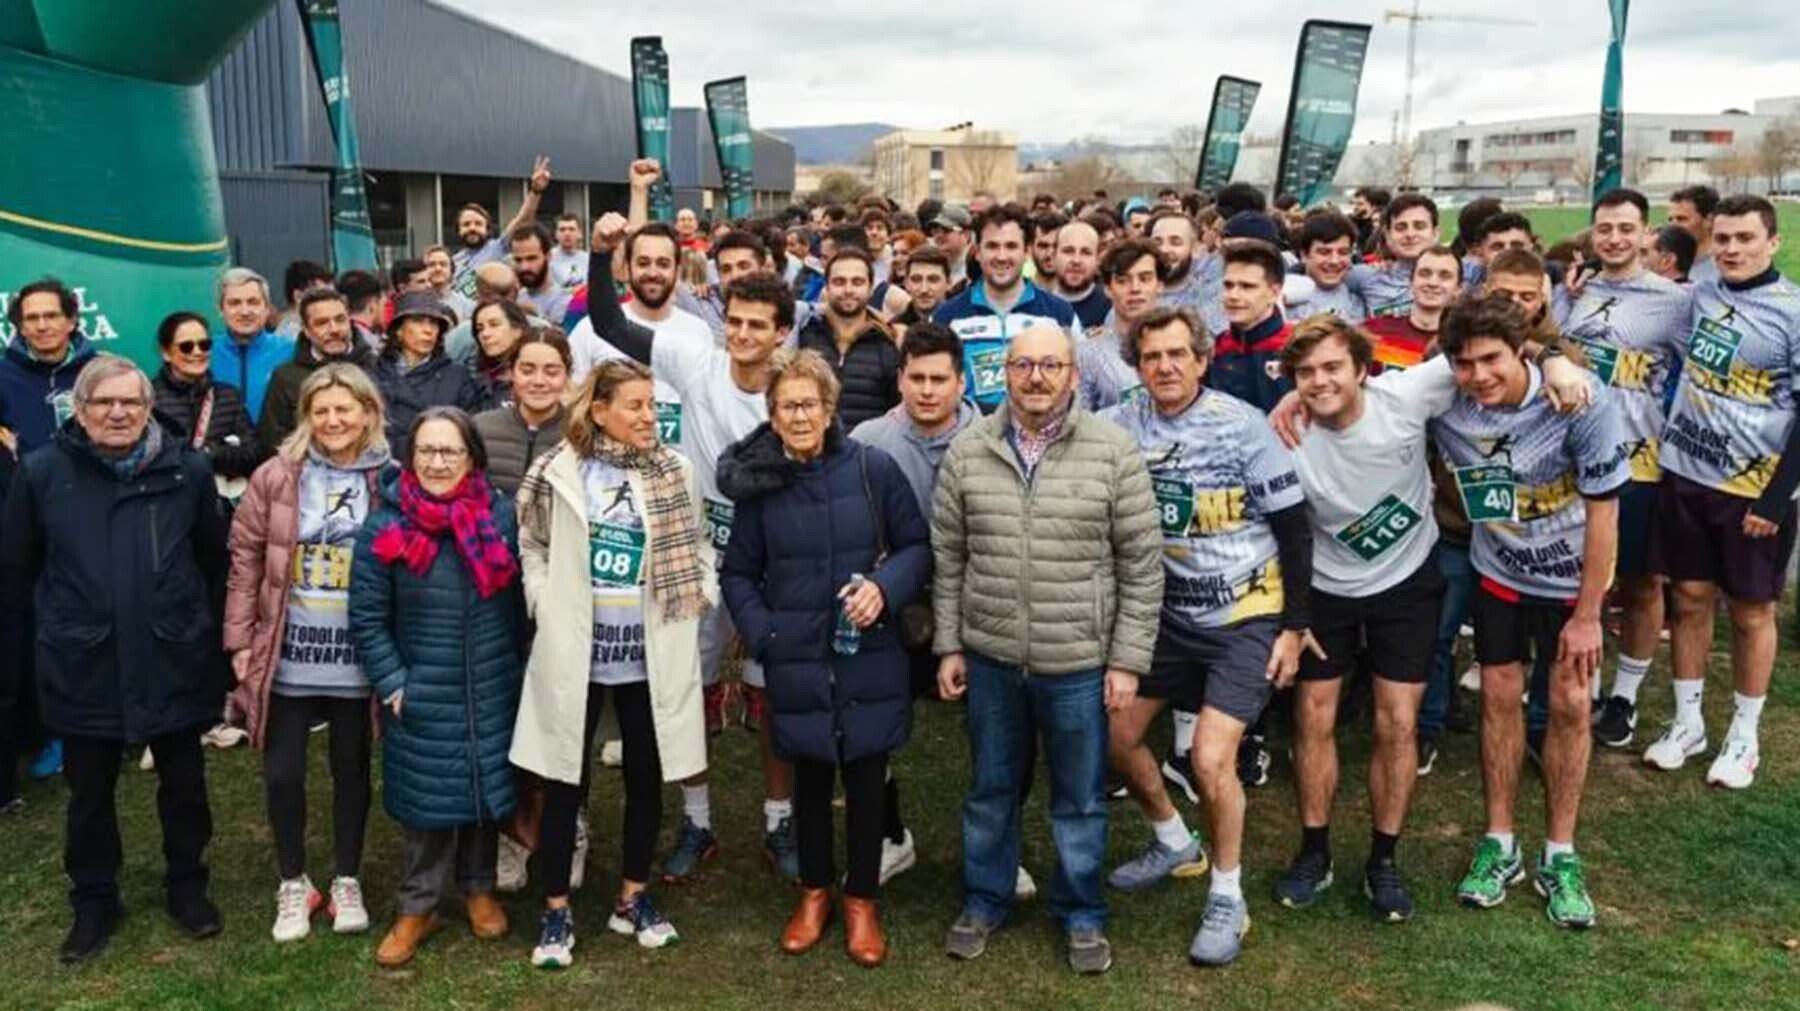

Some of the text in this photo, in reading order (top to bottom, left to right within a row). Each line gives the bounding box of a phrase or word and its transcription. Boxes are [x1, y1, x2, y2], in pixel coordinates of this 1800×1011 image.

[1692, 338, 1728, 366] 207
[1484, 488, 1512, 511] 40
[1361, 512, 1410, 549] 116
